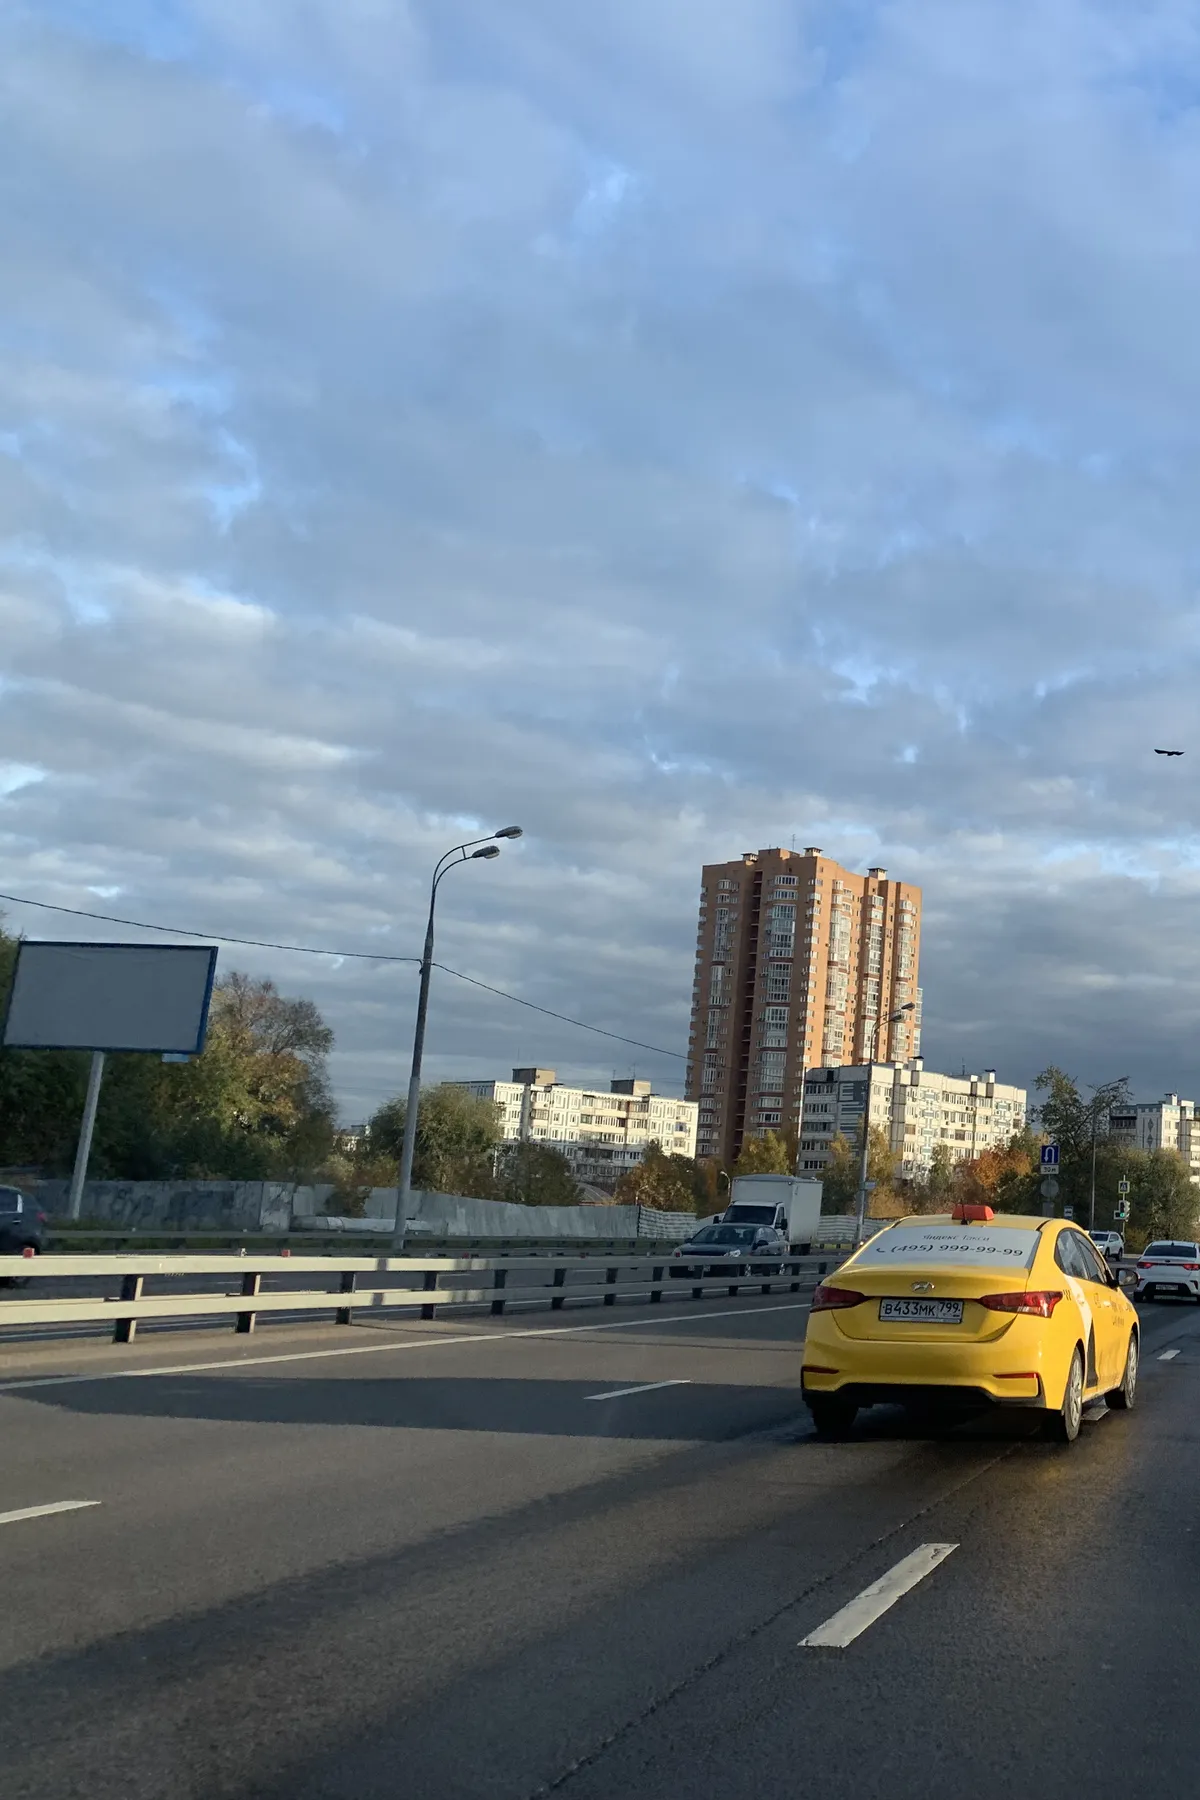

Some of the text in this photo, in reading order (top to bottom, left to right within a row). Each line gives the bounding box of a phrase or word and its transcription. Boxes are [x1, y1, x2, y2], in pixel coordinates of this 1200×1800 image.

[891, 1244, 1023, 1256] (495) 999-99-99
[939, 1301, 960, 1313] 799
